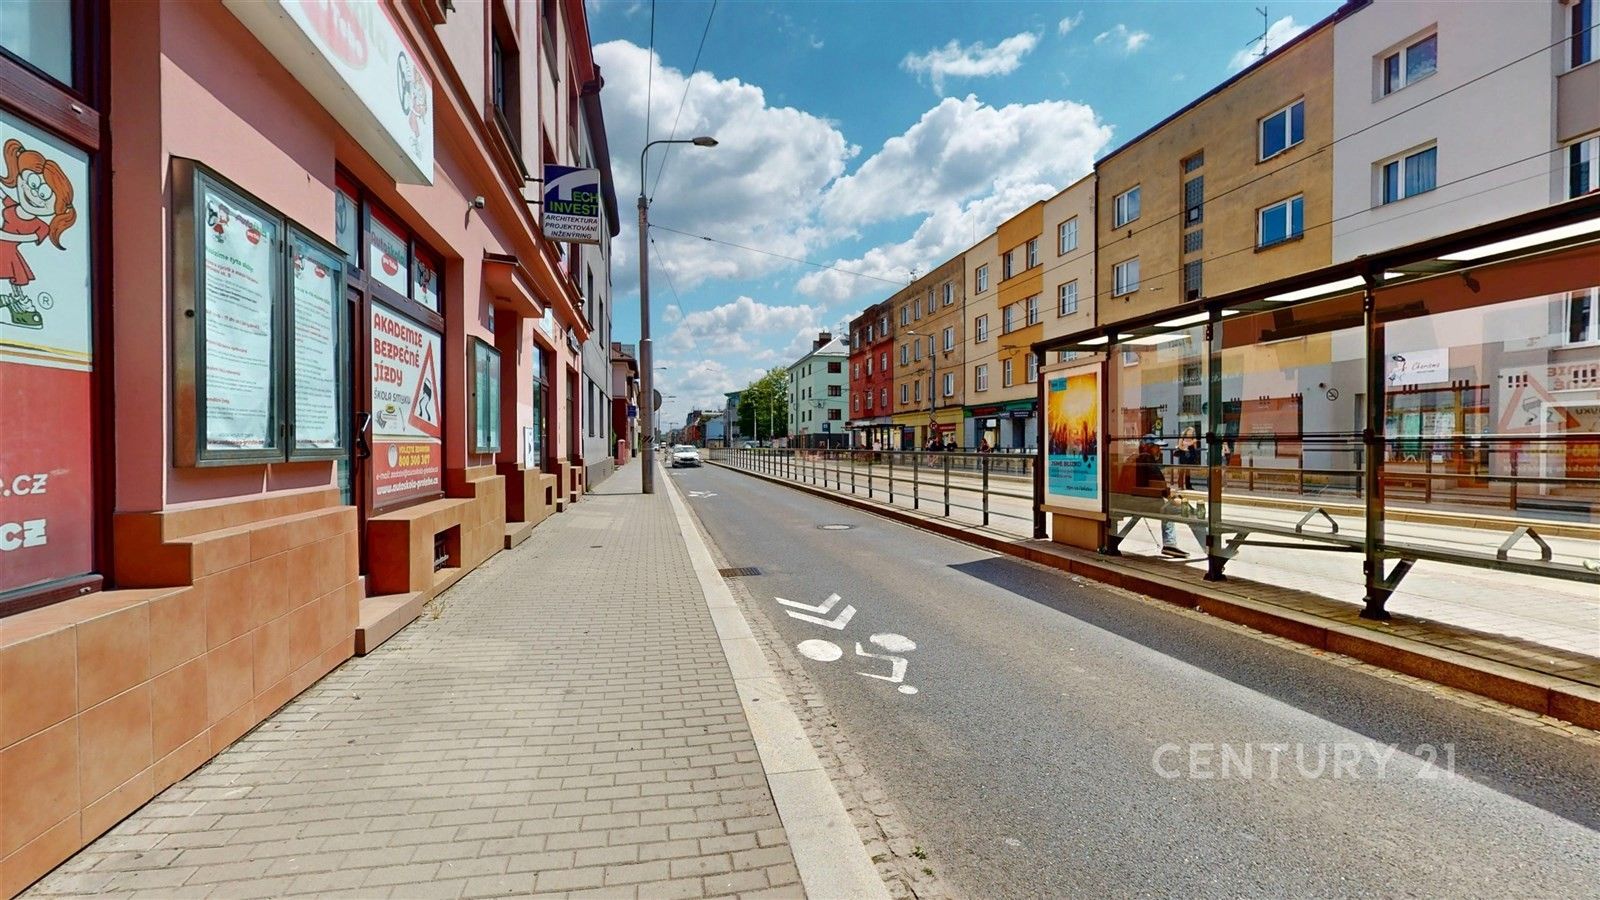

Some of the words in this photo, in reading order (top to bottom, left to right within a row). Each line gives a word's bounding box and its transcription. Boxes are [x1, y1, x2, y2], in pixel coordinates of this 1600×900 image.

[549, 201, 599, 215] INVEST
[545, 214, 598, 224] ARCHITEKTURA
[544, 222, 598, 232] PROJEKTOVÁNÍ
[551, 230, 592, 240] INŽENÝRING
[374, 313, 423, 348] AKADEMIE
[374, 338, 420, 368] BEZPEČNÉ
[373, 360, 403, 387] JÍZDY
[373, 386, 392, 402] ŠKOLA
